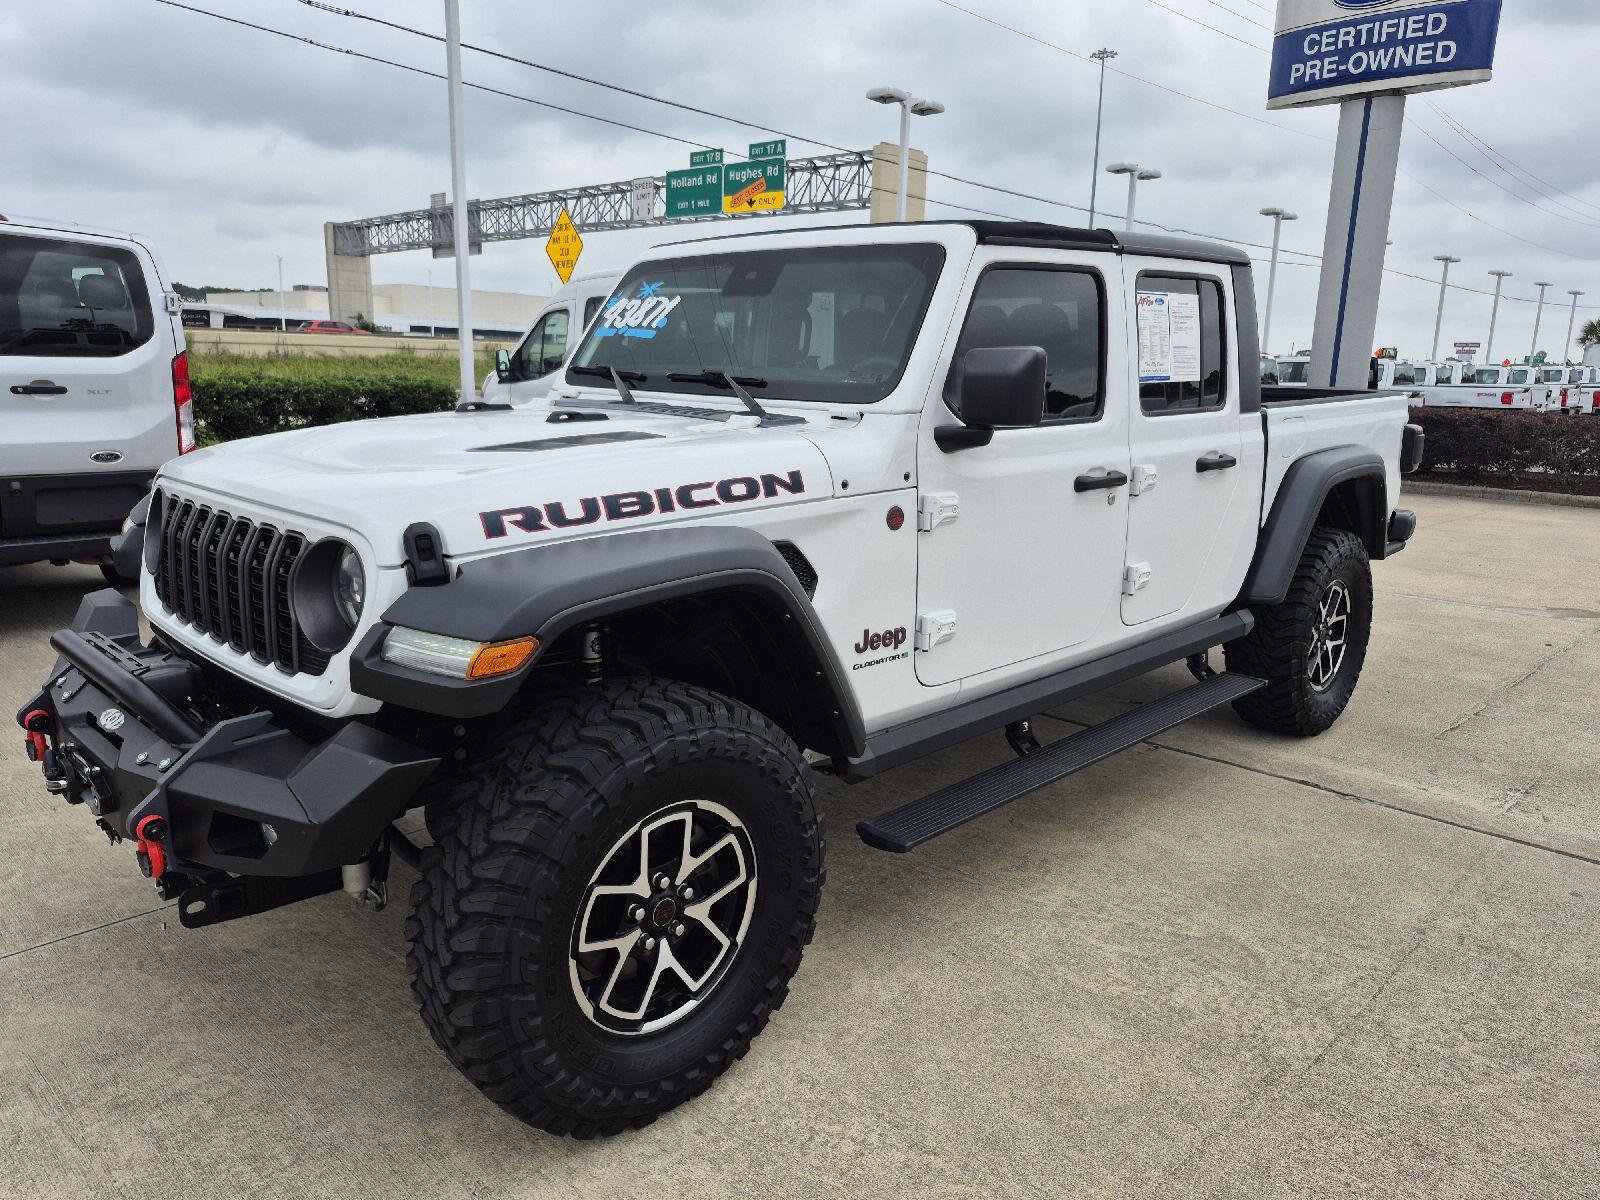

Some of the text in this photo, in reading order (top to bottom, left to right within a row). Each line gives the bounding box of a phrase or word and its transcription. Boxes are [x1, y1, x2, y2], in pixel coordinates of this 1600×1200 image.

[1303, 12, 1448, 56] CERTIFIED
[1289, 40, 1457, 85] PRE-OWNED
[692, 155, 705, 163] EXIT
[751, 147, 764, 156] EXIT
[671, 172, 718, 189] Holland Rd
[729, 165, 779, 182] Hughes Rd
[634, 182, 653, 191] SPEED
[636, 192, 651, 200] LIMIT
[677, 201, 688, 209] EXIT
[697, 199, 710, 207] MILE
[758, 196, 777, 205] ONLY
[478, 469, 806, 540] RUBICON
[854, 625, 907, 654] Jeep
[852, 654, 901, 671] GLADIATOR
